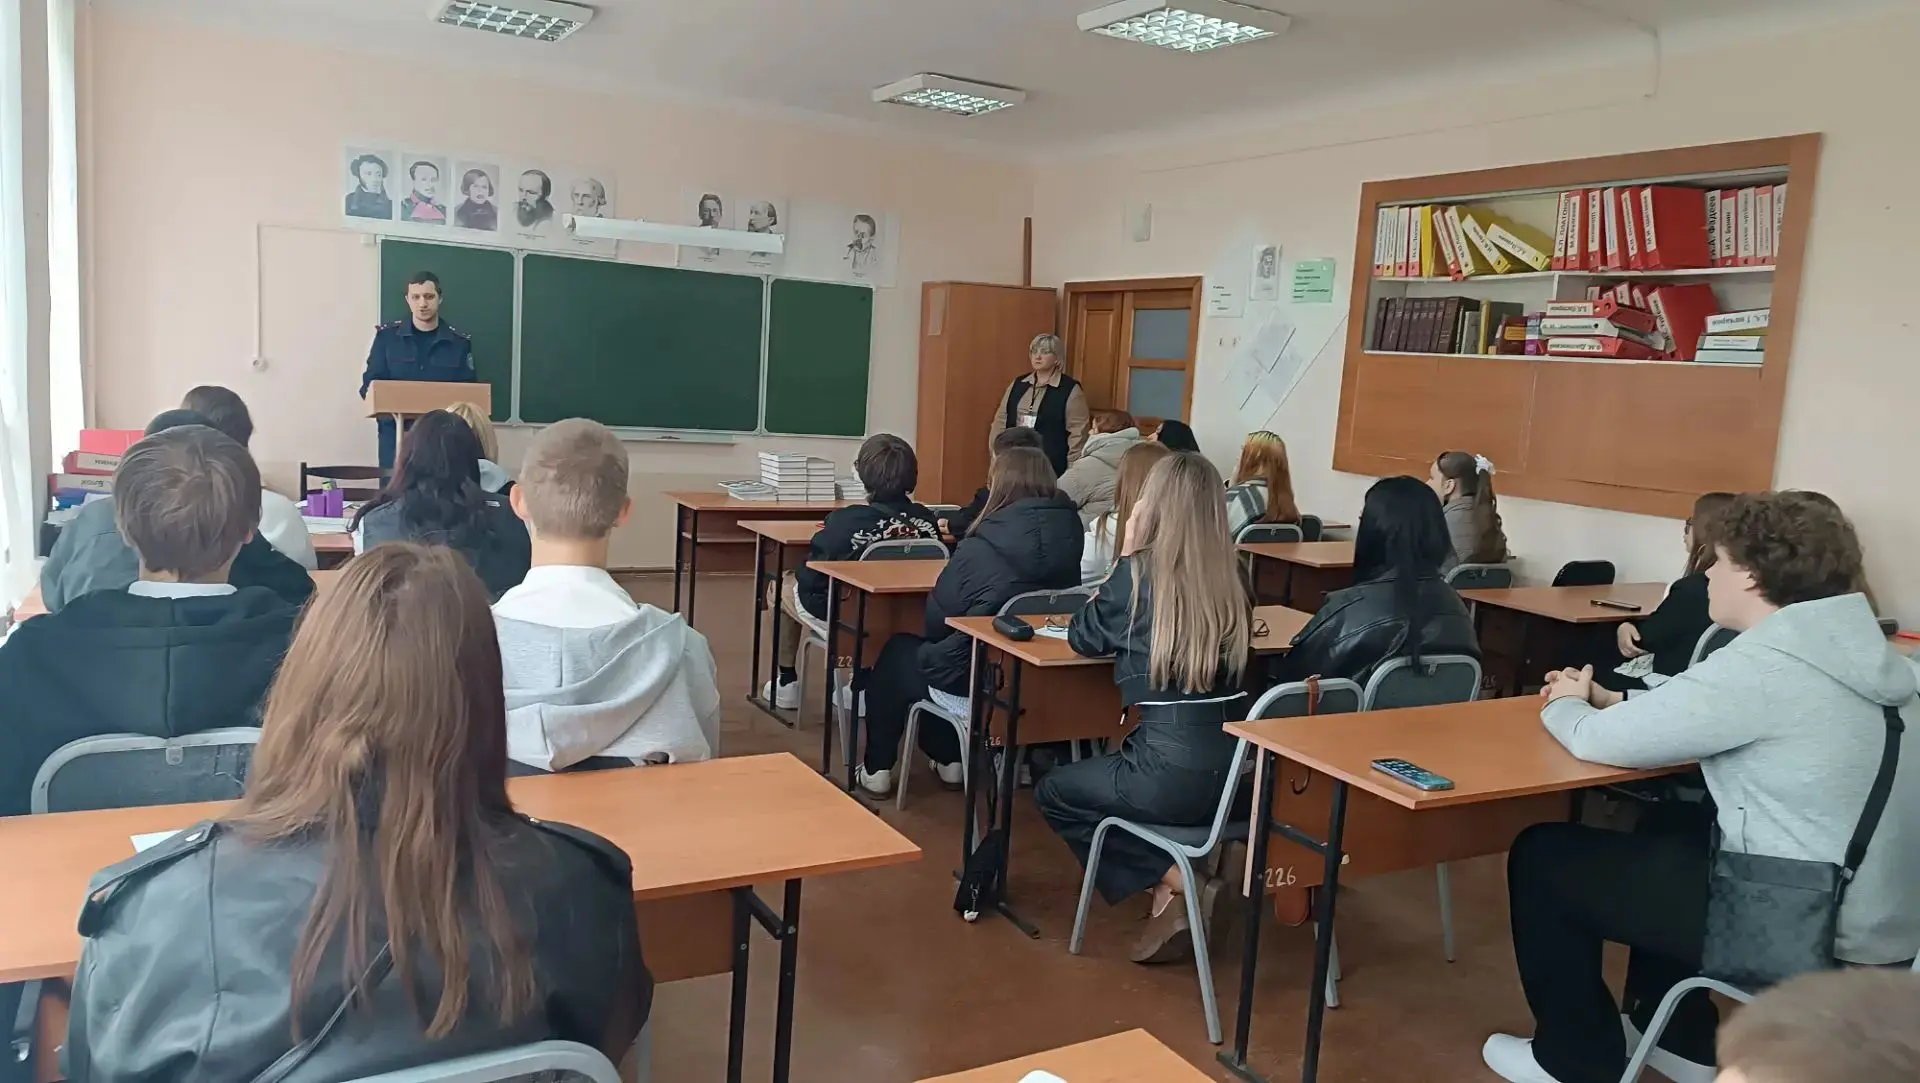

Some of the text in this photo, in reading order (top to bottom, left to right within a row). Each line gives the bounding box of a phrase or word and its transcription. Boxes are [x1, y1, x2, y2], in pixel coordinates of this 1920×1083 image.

[1707, 195, 1717, 233] Фадеев
[837, 655, 853, 668] 22
[1264, 866, 1296, 888] 226
